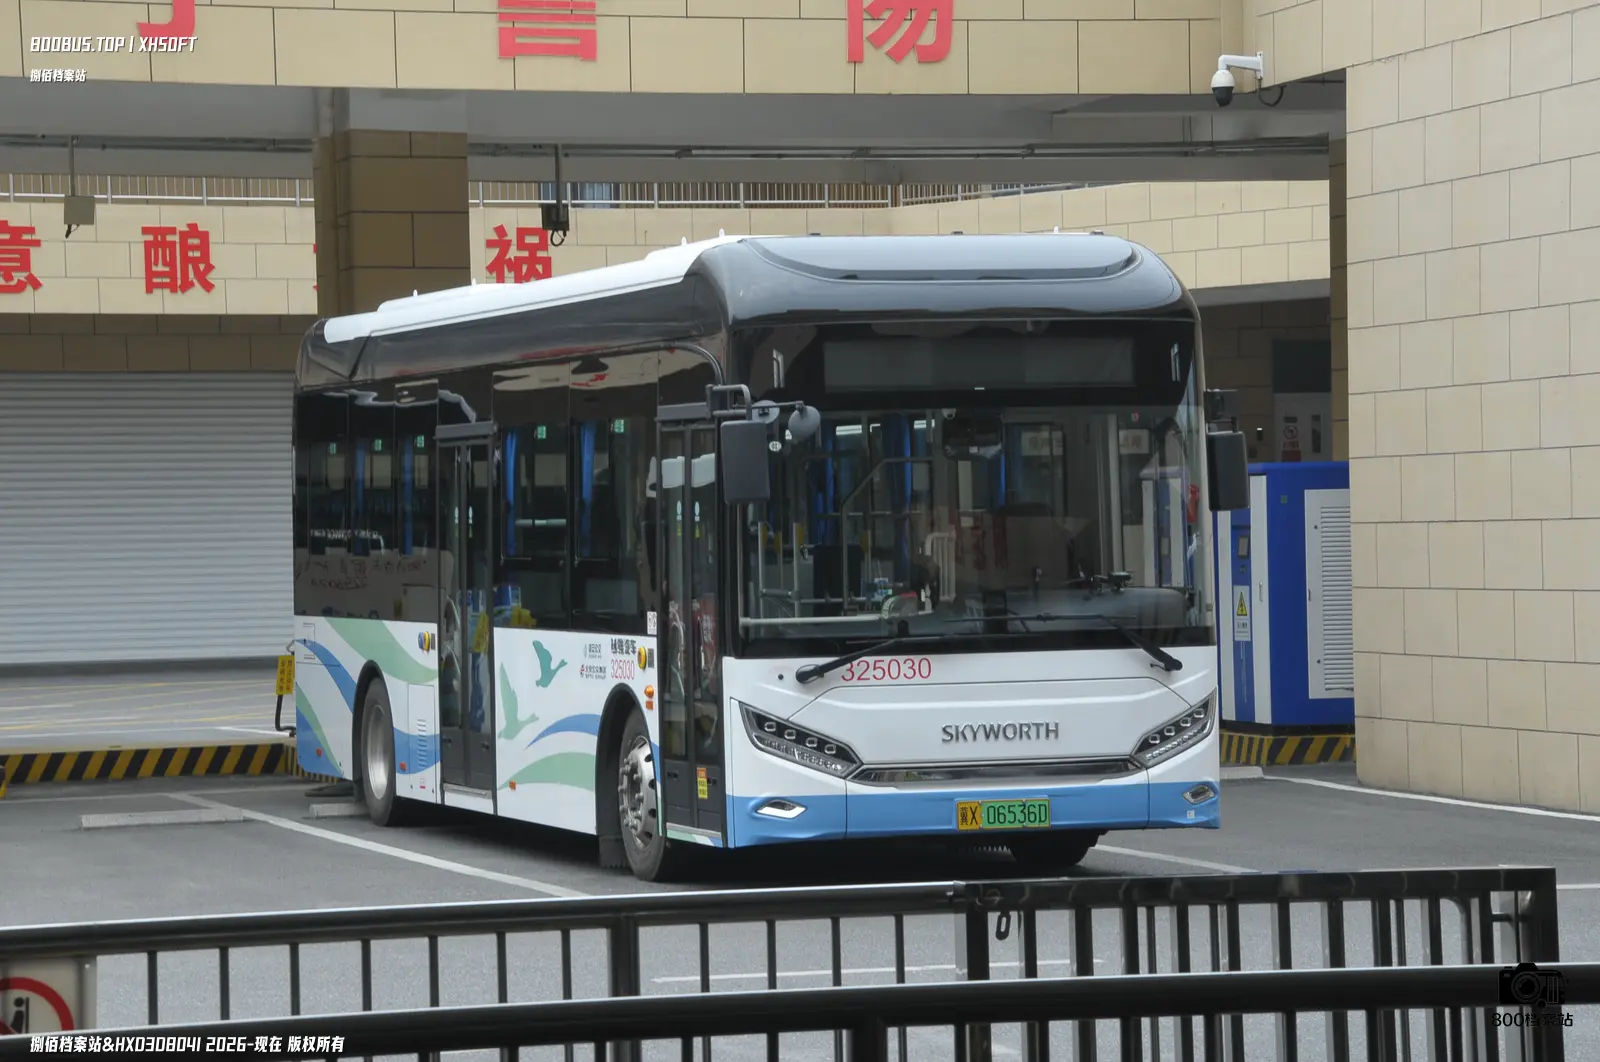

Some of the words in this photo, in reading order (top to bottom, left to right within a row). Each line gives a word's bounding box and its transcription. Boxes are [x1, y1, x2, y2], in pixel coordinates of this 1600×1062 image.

[611, 659, 635, 680] 325030
[841, 658, 932, 682] 325030
[941, 721, 1060, 743] SKYWORTH
[986, 803, 1048, 825] 06536D
